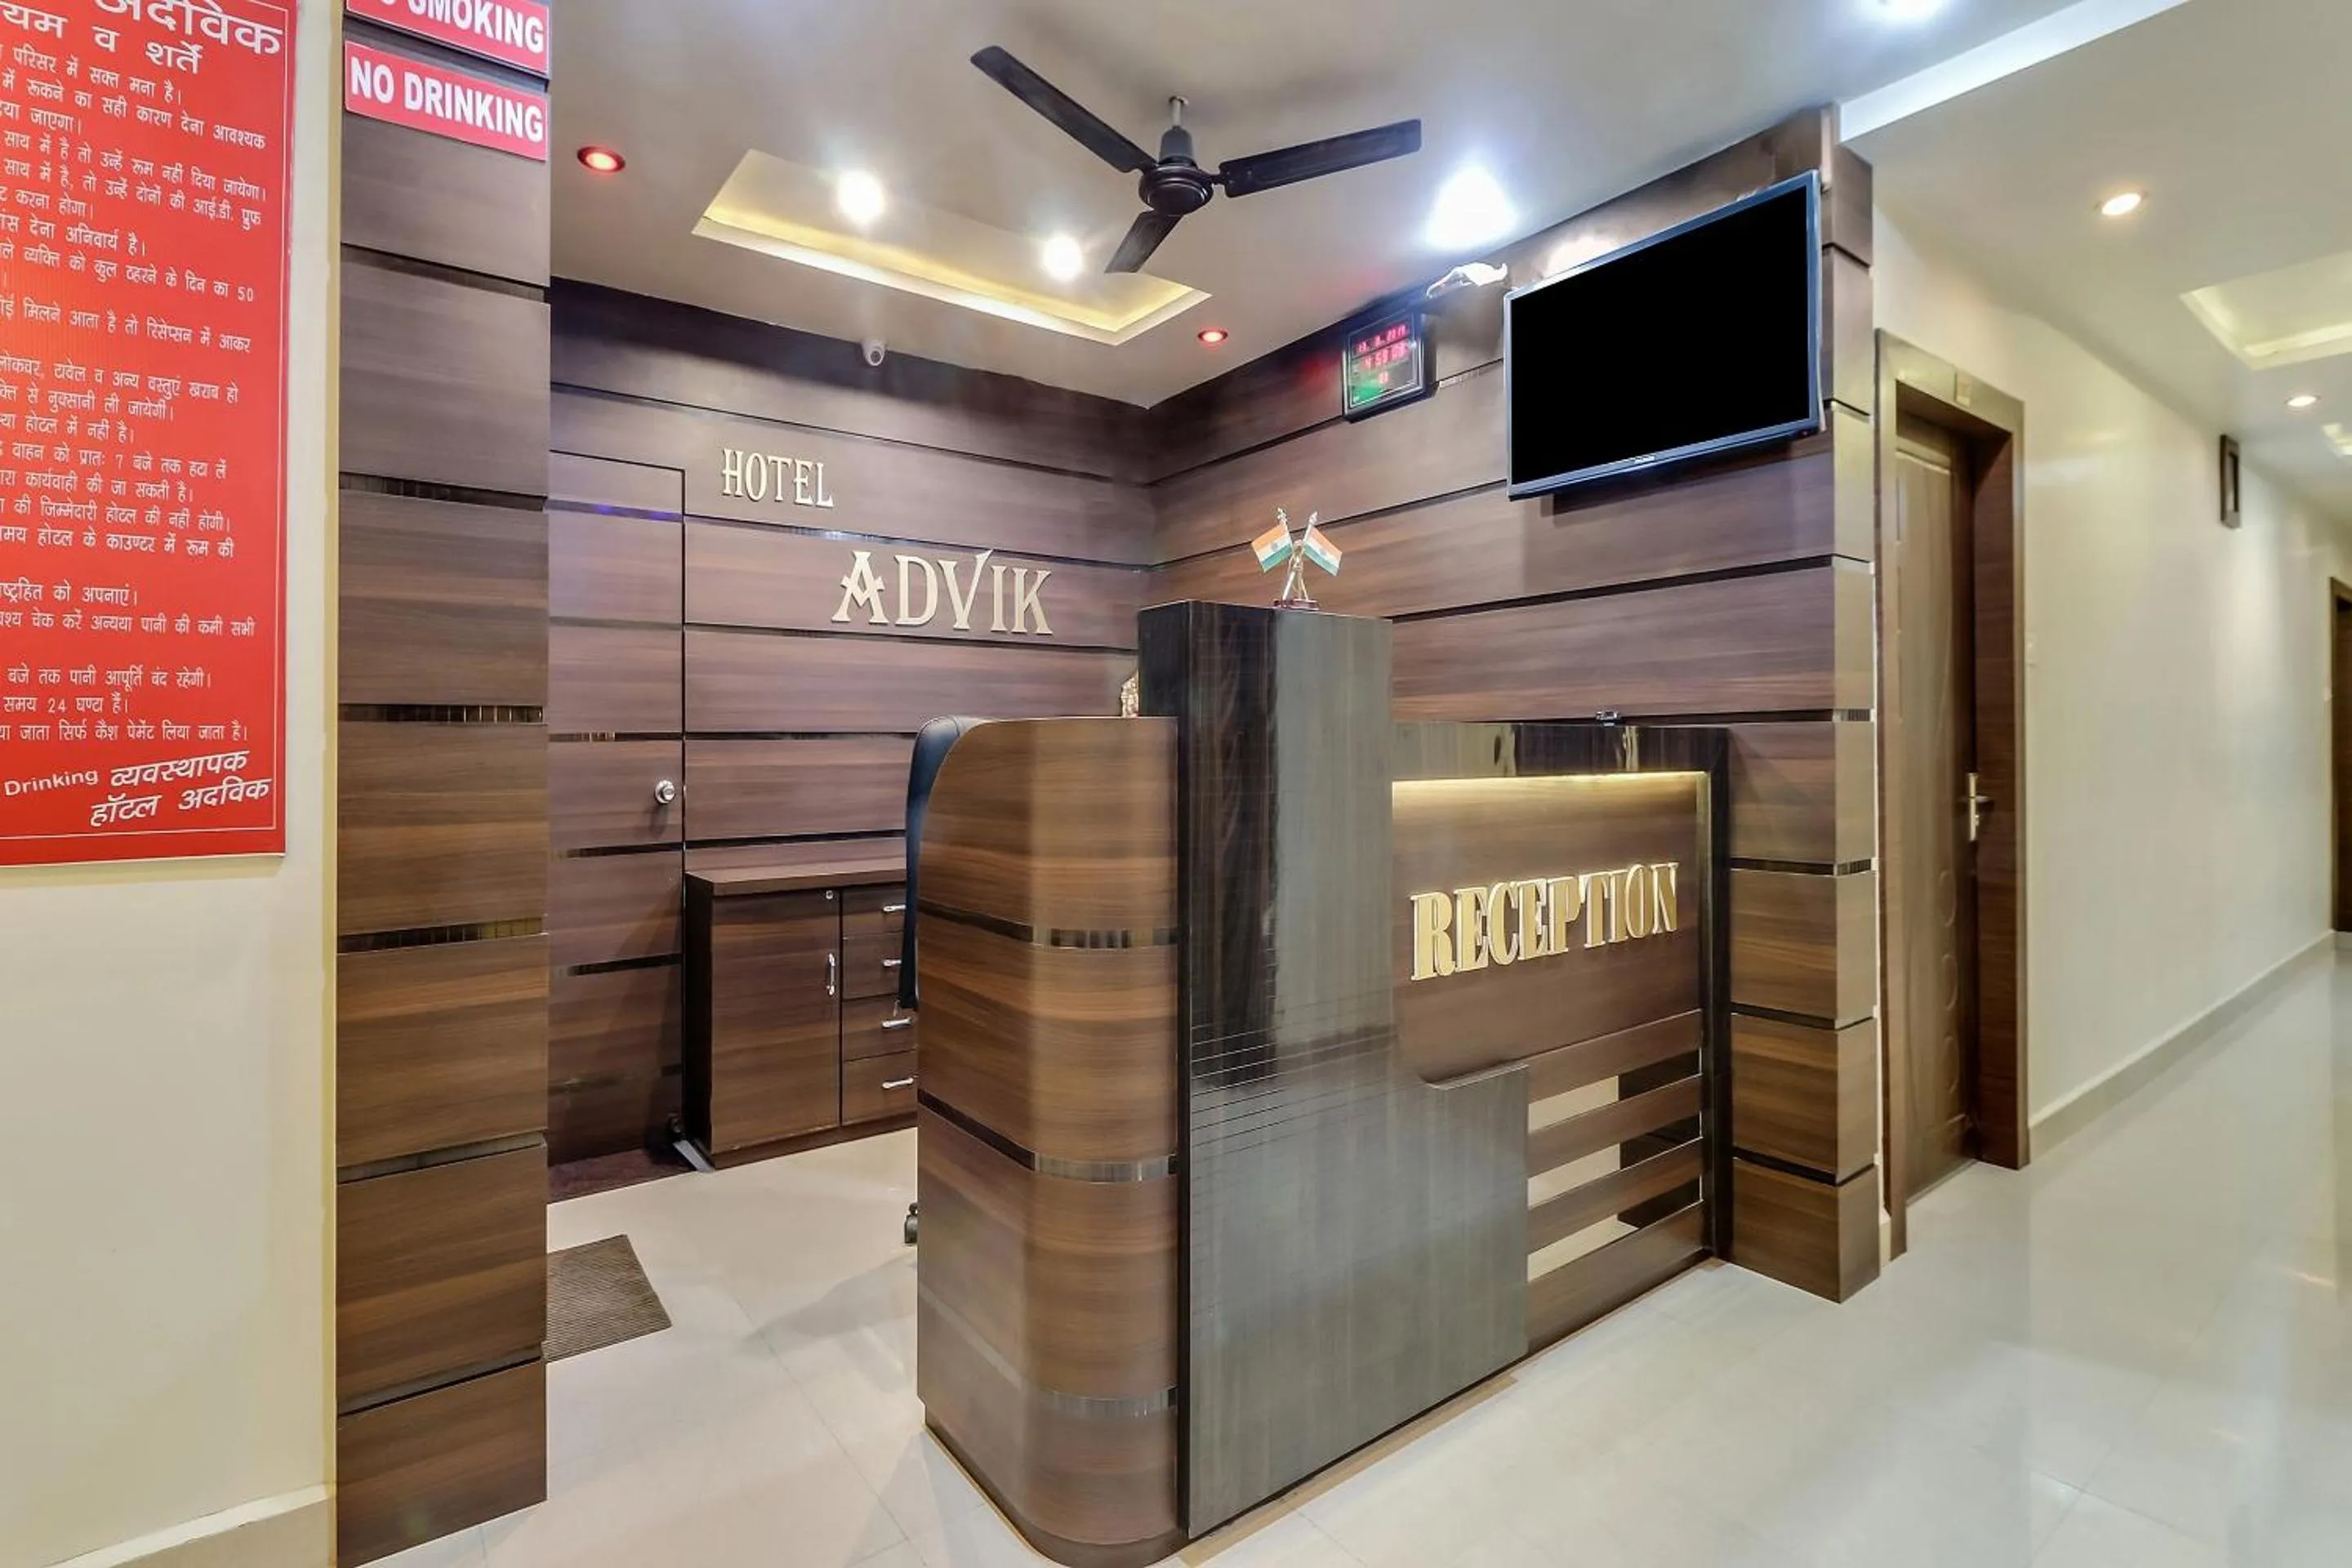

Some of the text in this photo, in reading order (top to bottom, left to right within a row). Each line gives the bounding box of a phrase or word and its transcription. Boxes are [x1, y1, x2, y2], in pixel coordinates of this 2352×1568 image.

[91, 27, 121, 52] व
[74, 91, 92, 109] का
[351, 56, 543, 142] NO DRINKING
[29, 213, 56, 238] देना
[238, 287, 255, 301] 50
[722, 448, 834, 507] HOTEL
[38, 523, 74, 547] होटल
[53, 579, 71, 601] को
[831, 549, 1054, 635] ADVIK
[38, 669, 61, 684] तक
[69, 665, 96, 685] पानी
[2, 697, 38, 712] समय
[48, 698, 67, 713] 24
[20, 726, 51, 741] जाता
[161, 720, 191, 740] लिया
[198, 725, 225, 740] जाता
[111, 751, 250, 786] व्यवस्थापक
[4, 770, 99, 795] Drinking
[91, 776, 272, 826] हॉटल अदविक
[1410, 862, 1679, 981] RECEPTION
